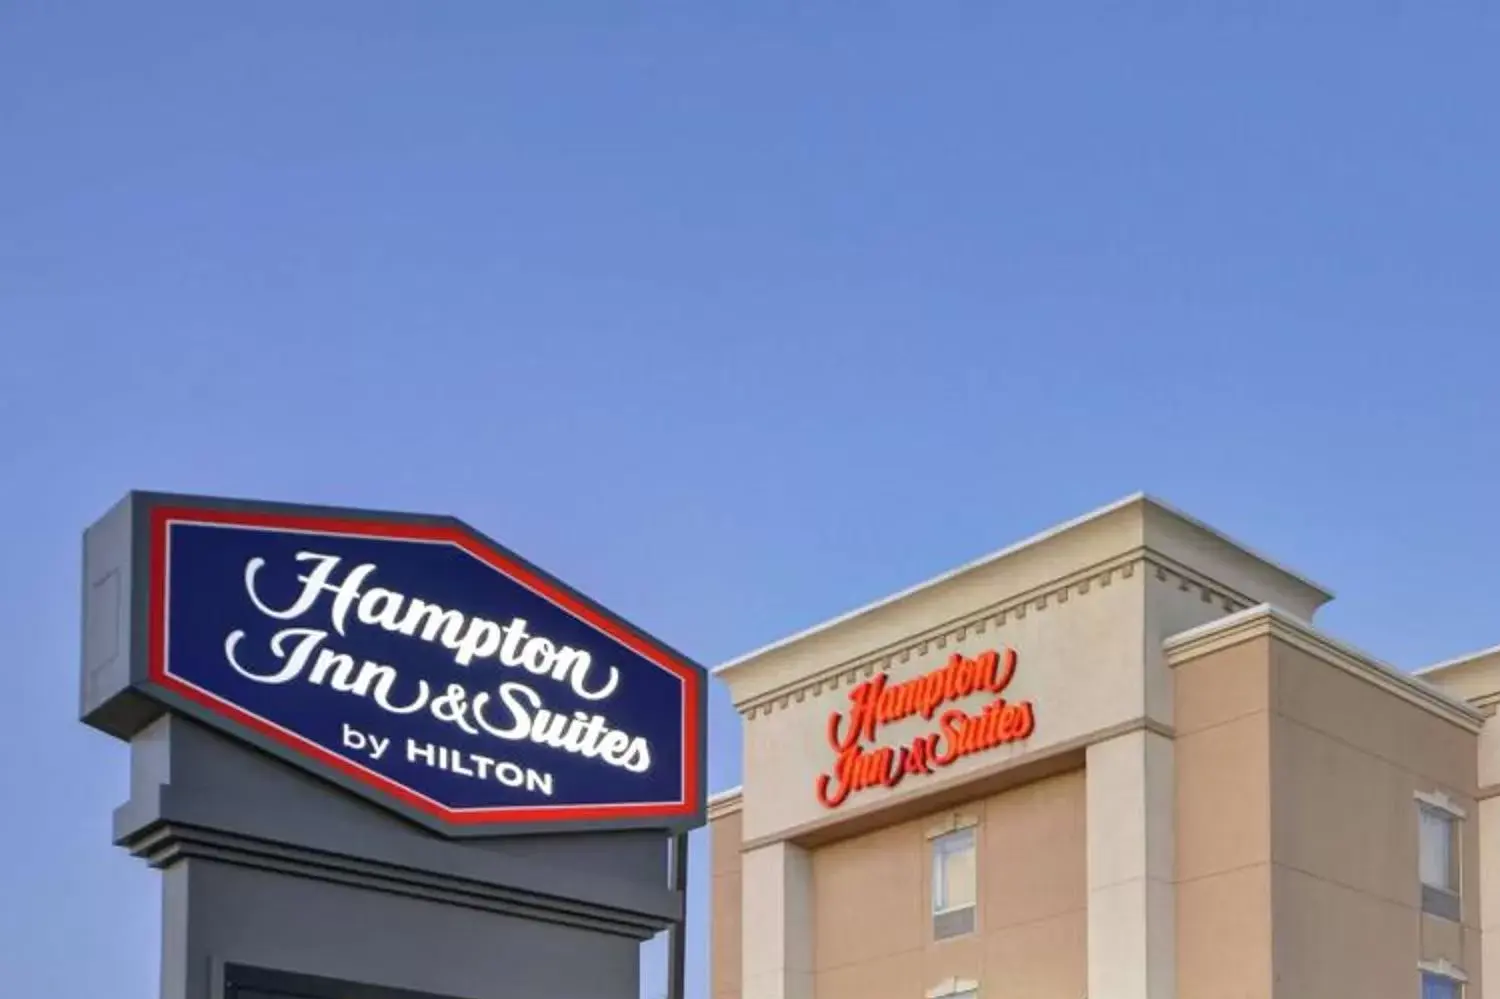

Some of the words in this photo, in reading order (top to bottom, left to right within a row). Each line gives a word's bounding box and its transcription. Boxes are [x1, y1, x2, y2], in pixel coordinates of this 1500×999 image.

[245, 551, 620, 700] Hampton
[224, 627, 428, 714] Inn
[431, 679, 480, 735] &
[472, 683, 652, 774] Suites
[817, 747, 906, 808] Inn
[928, 698, 1036, 765] Suites
[826, 647, 1018, 752] Hampton
[341, 723, 391, 760] by
[406, 738, 555, 796] HILTON
